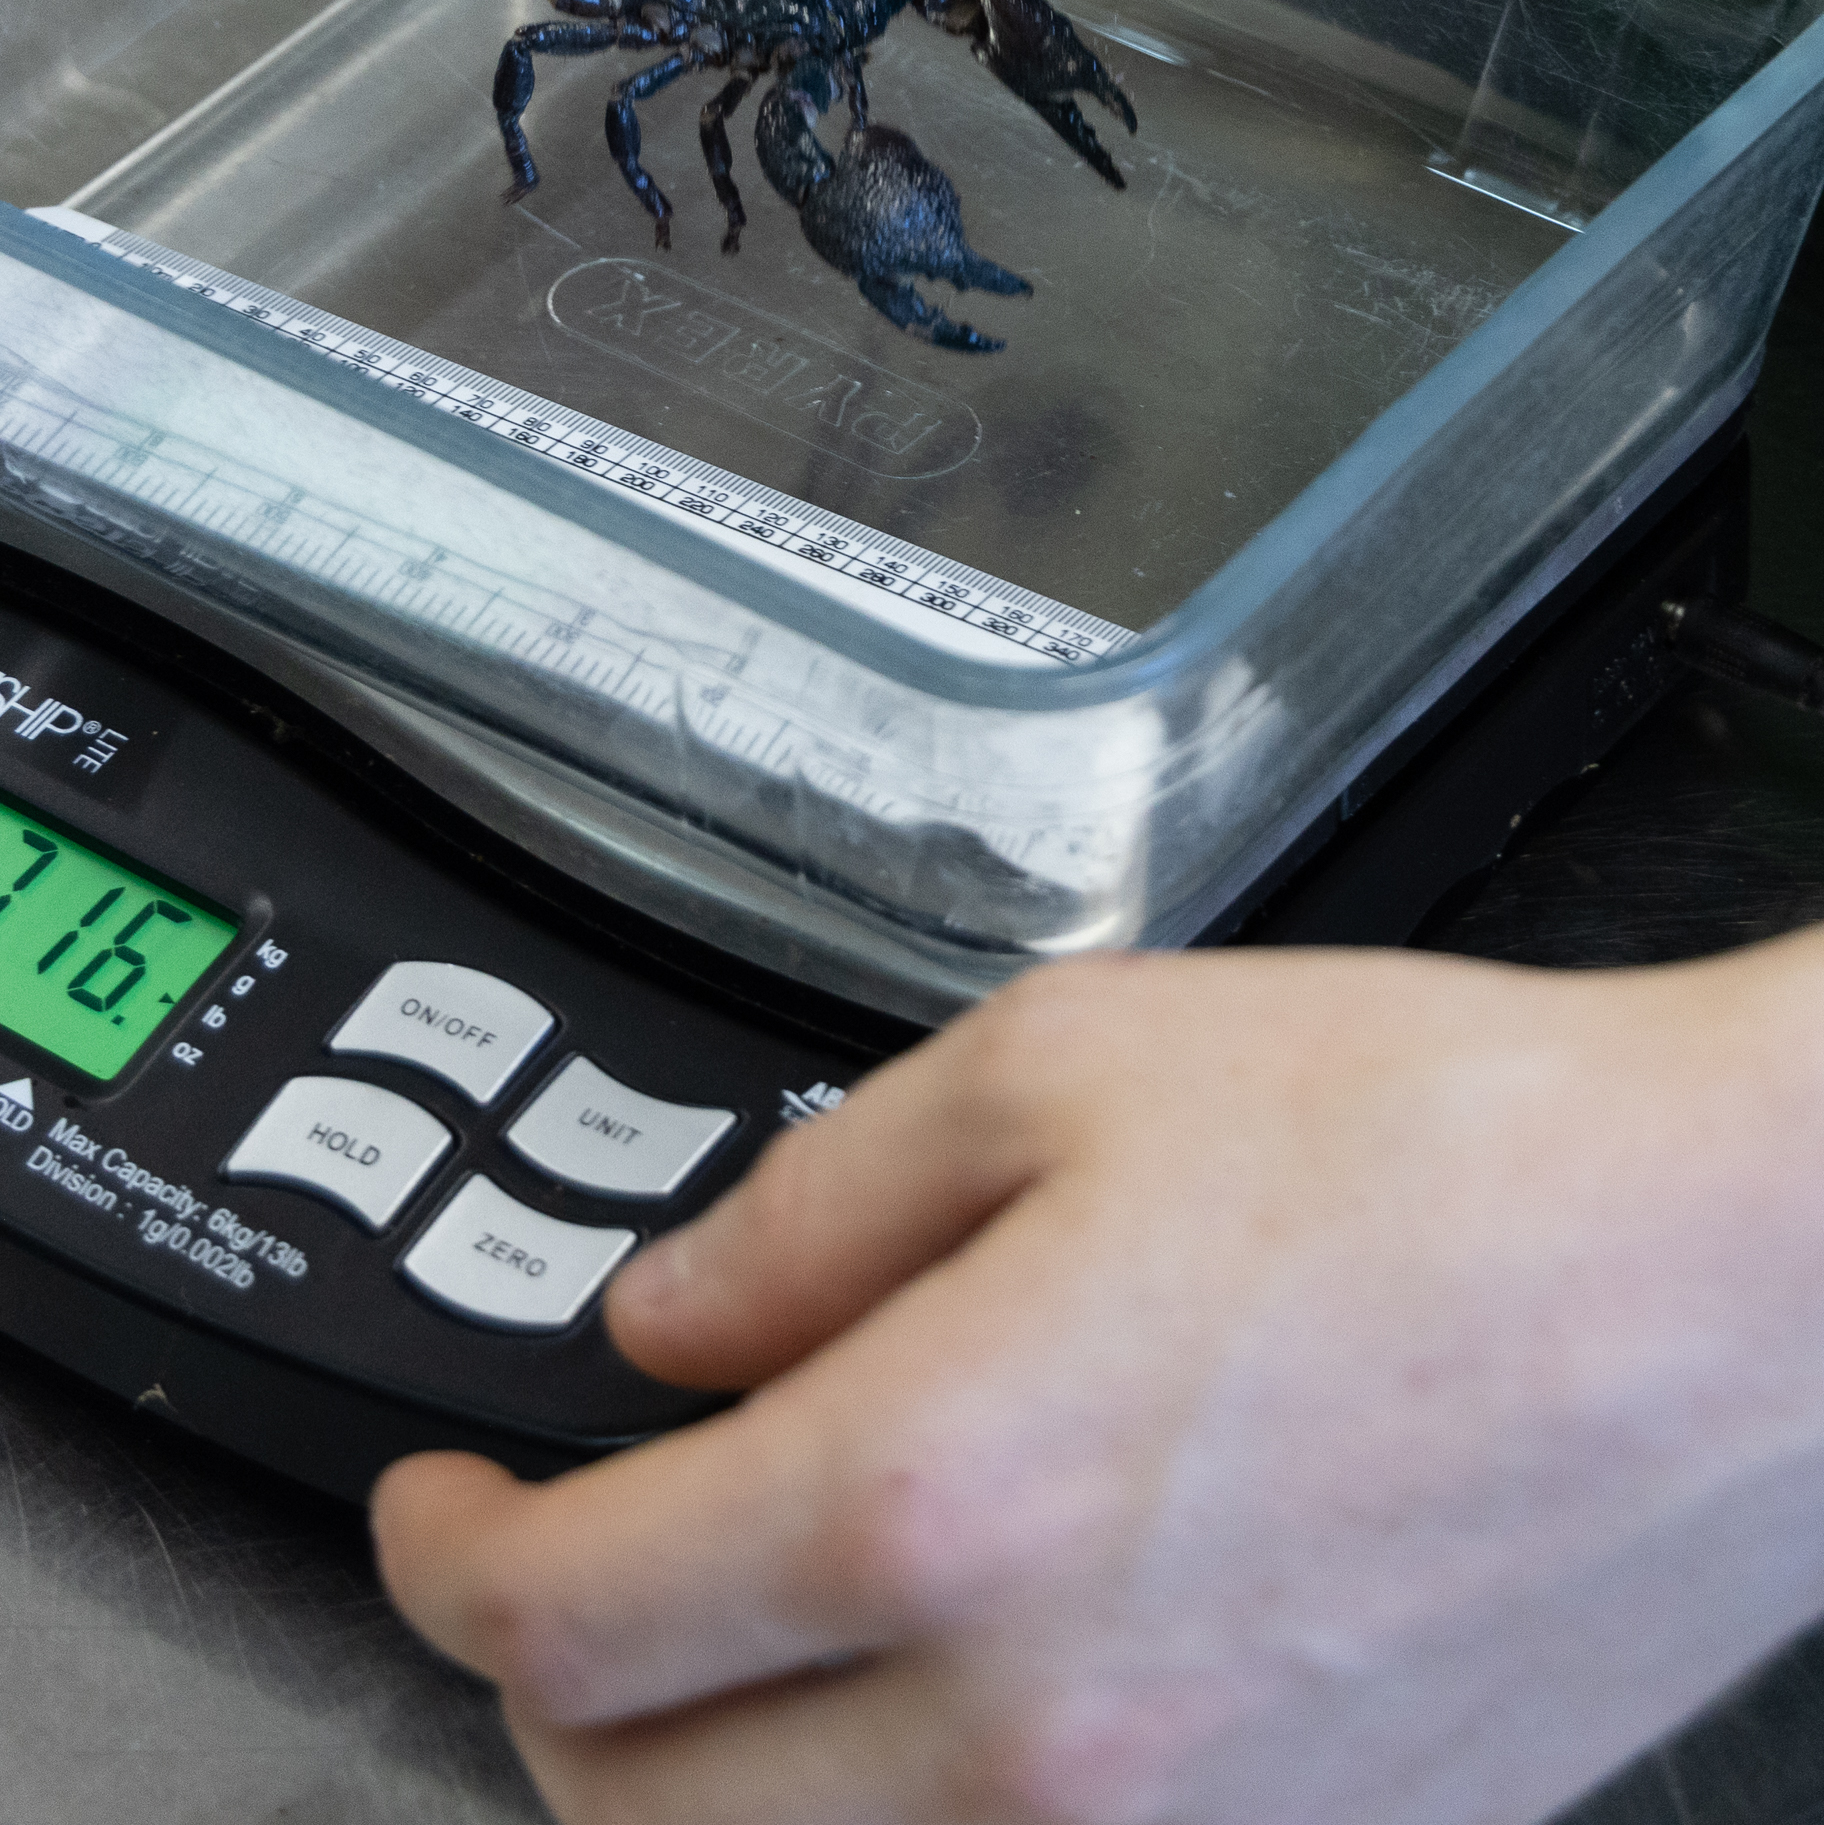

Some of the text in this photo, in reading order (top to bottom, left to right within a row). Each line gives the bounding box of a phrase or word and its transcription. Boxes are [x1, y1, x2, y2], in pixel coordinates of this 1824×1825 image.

[585, 269, 943, 455] PYREX
[188, 281, 216, 298] 20
[242, 304, 272, 320] 30
[299, 327, 327, 343] 40
[353, 349, 382, 365] 50
[408, 371, 438, 388] 60
[467, 393, 495, 410] 70
[523, 416, 552, 433] 80
[579, 439, 609, 455] 90
[639, 461, 671, 479] 100
[696, 484, 730, 503] 110
[755, 508, 790, 526] 120
[817, 532, 850, 551] 130
[876, 555, 910, 574] 140
[936, 579, 971, 599] 150
[1000, 605, 1034, 624] 160
[1059, 628, 1093, 648] 170
[395, 381, 426, 399] 120
[452, 404, 484, 422] 140
[507, 427, 541, 445] 160
[565, 450, 598, 468] 180
[619, 473, 656, 491] 200
[678, 496, 715, 515] 220
[738, 520, 775, 539] 240
[797, 543, 835, 563] 260
[858, 567, 897, 588] 280
[918, 591, 957, 612] 300
[981, 616, 1020, 636] 320
[1043, 640, 1081, 661] 340
[72, 728, 129, 773] LITE
[256, 938, 289, 968] kg
[231, 975, 256, 995] g
[201, 1004, 227, 1028] lb
[400, 998, 497, 1049] ON/OFF
[172, 1041, 204, 1066] oz
[307, 1122, 381, 1166] HOLD
[578, 1107, 642, 1146] UNIT
[26, 1145, 118, 1211] Division
[138, 1209, 256, 1289] 1g/0.002lb
[48, 1117, 309, 1278] Max Capacity: 6kg/13lb
[473, 1232, 547, 1277] ZERO
